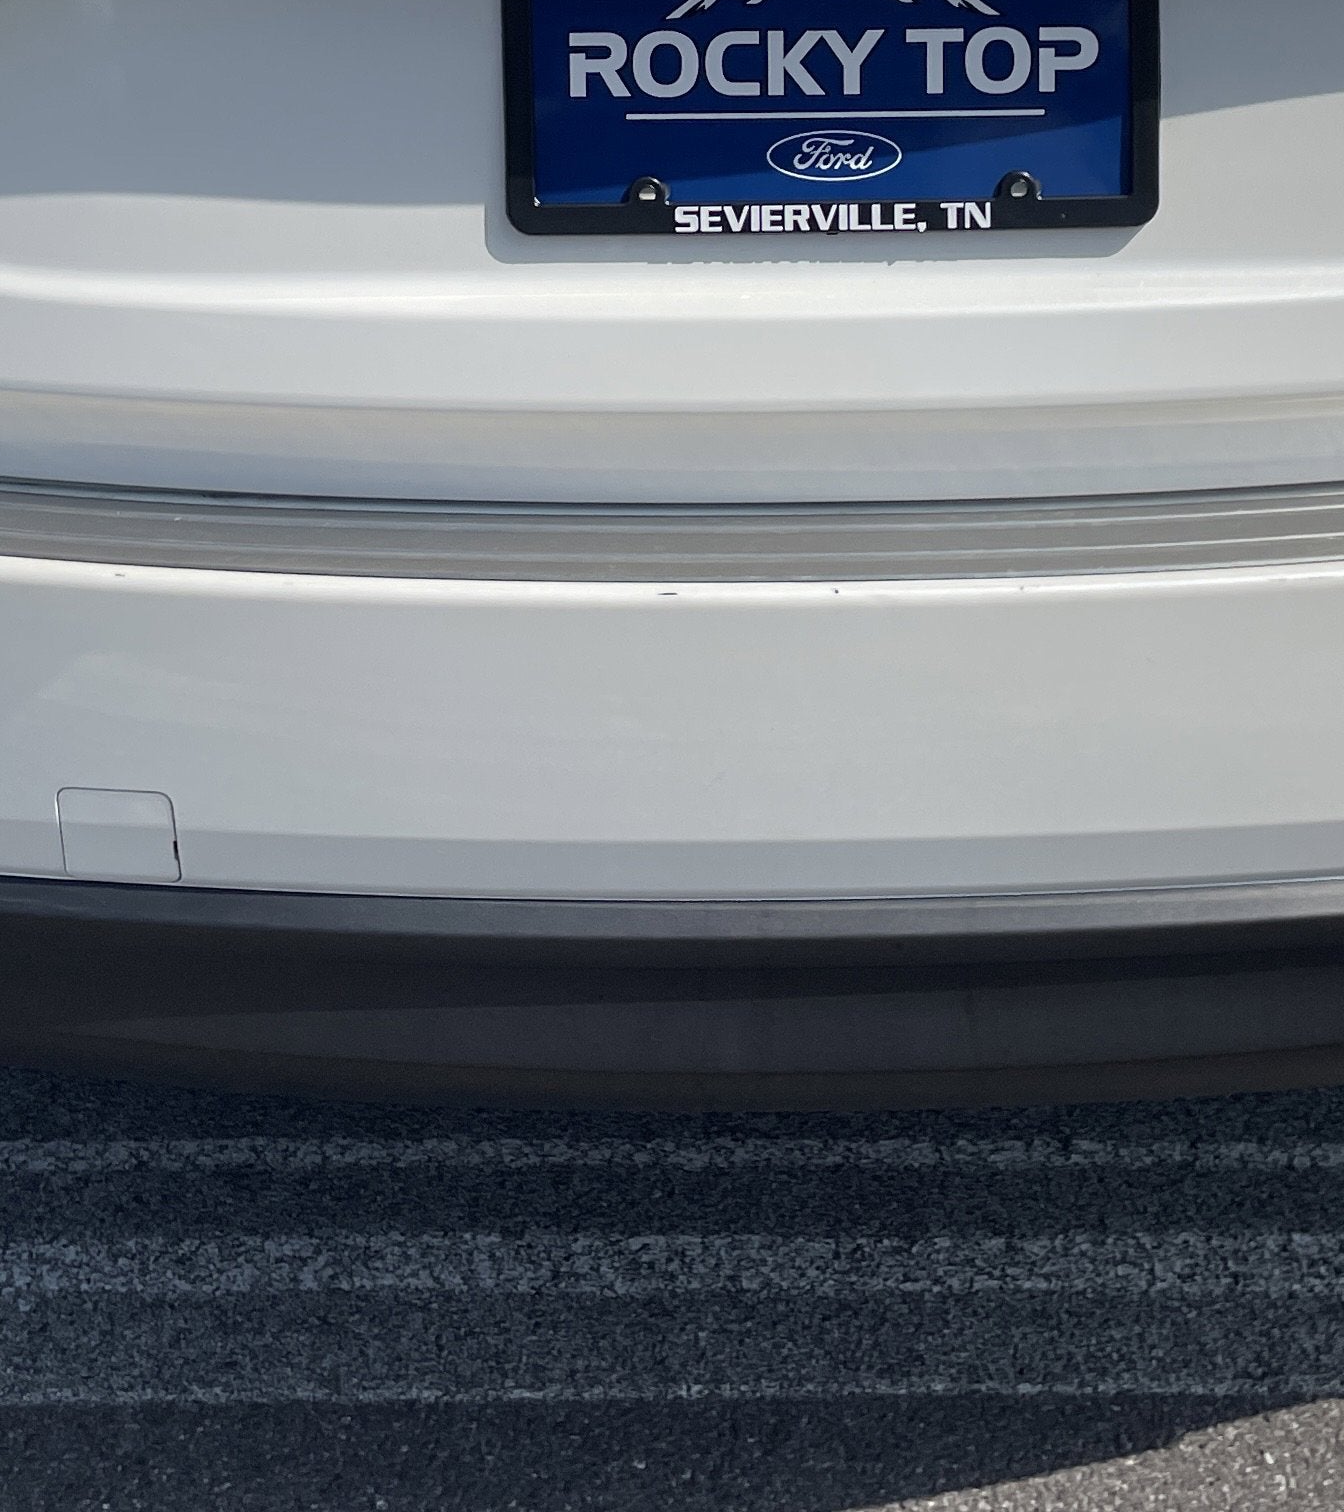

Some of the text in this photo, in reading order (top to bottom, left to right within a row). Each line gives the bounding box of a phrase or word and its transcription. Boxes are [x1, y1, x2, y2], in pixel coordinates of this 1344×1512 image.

[568, 25, 1100, 98] ROCKY TOP
[792, 136, 874, 172] Ford
[674, 201, 992, 234] SEVIERVILLE, TN
